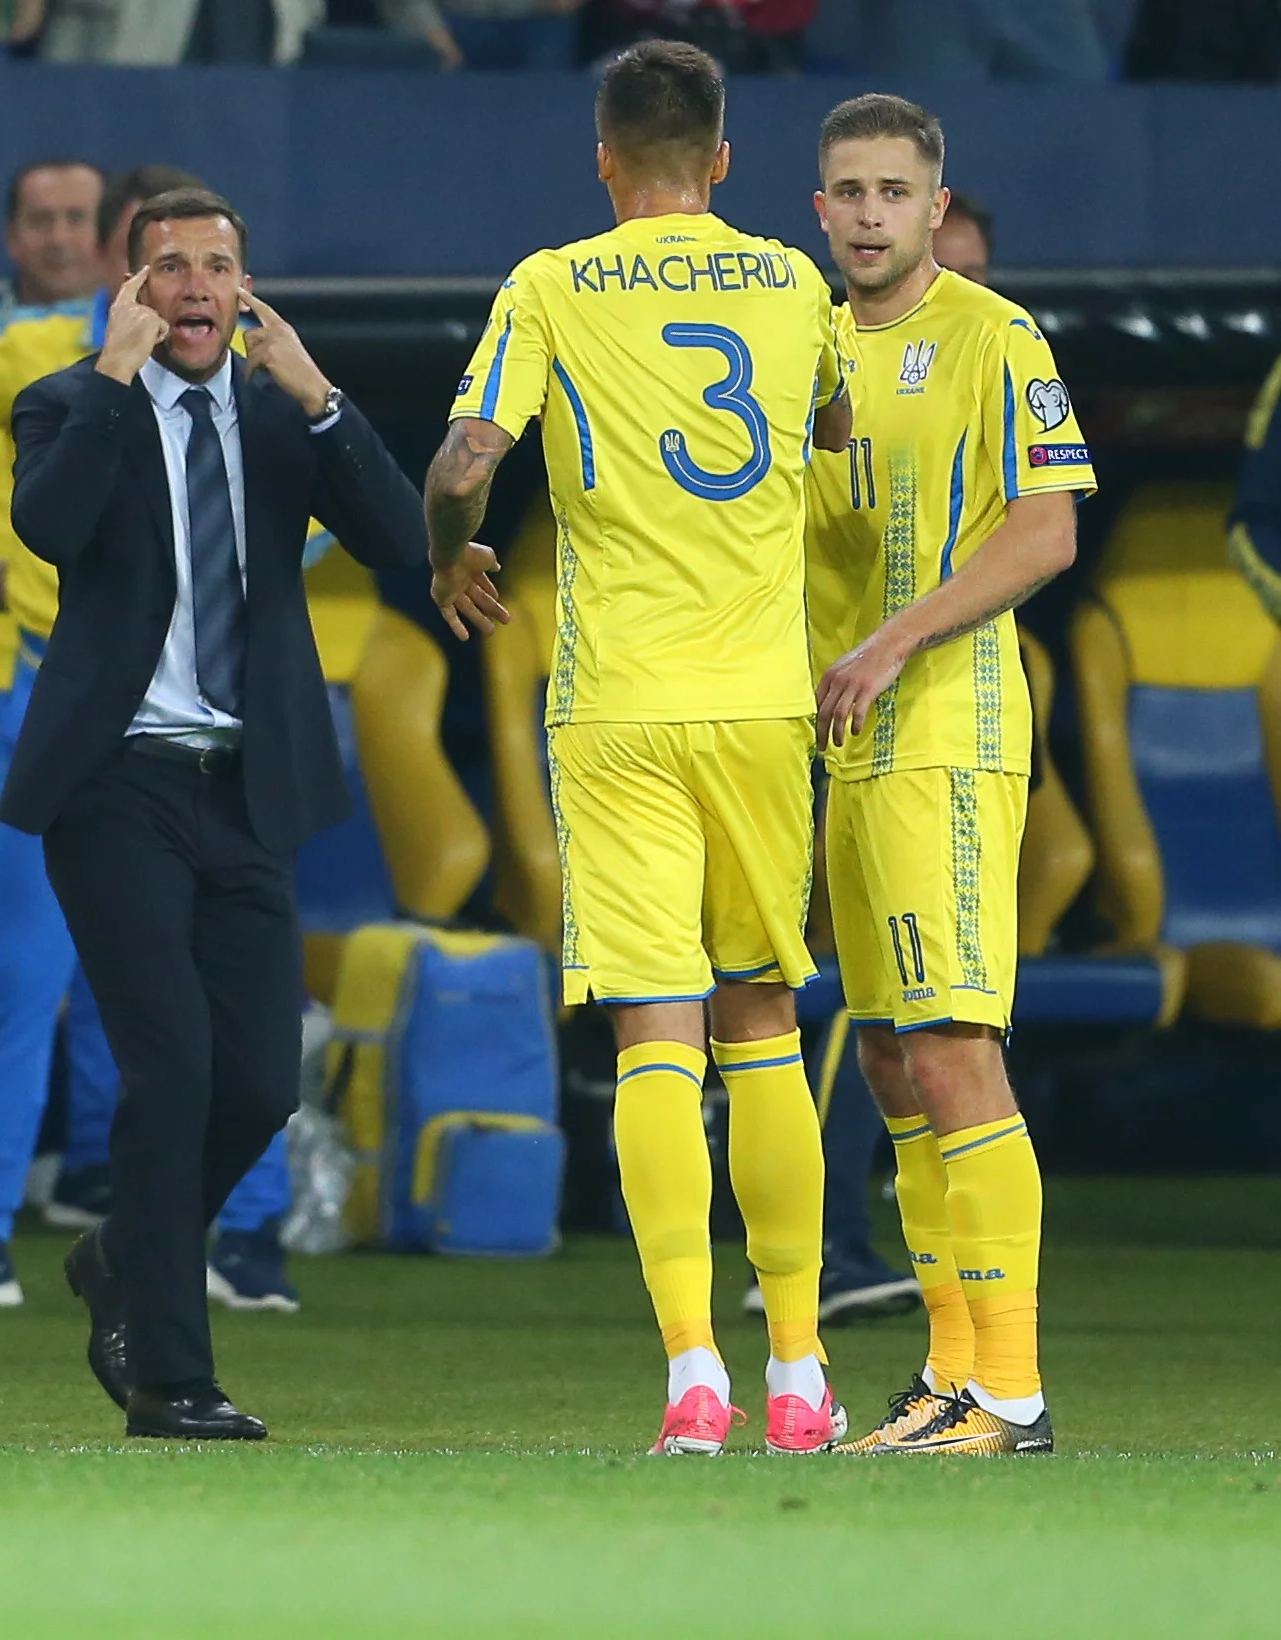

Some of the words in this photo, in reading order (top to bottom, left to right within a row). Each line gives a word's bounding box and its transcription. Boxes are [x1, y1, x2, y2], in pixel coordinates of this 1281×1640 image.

[571, 253, 797, 293] KHACHERIDI
[660, 323, 772, 501] 3
[848, 437, 876, 510] 11
[1047, 448, 1089, 460] RESPECT
[887, 912, 925, 987] 11
[959, 1268, 1005, 1280] ma
